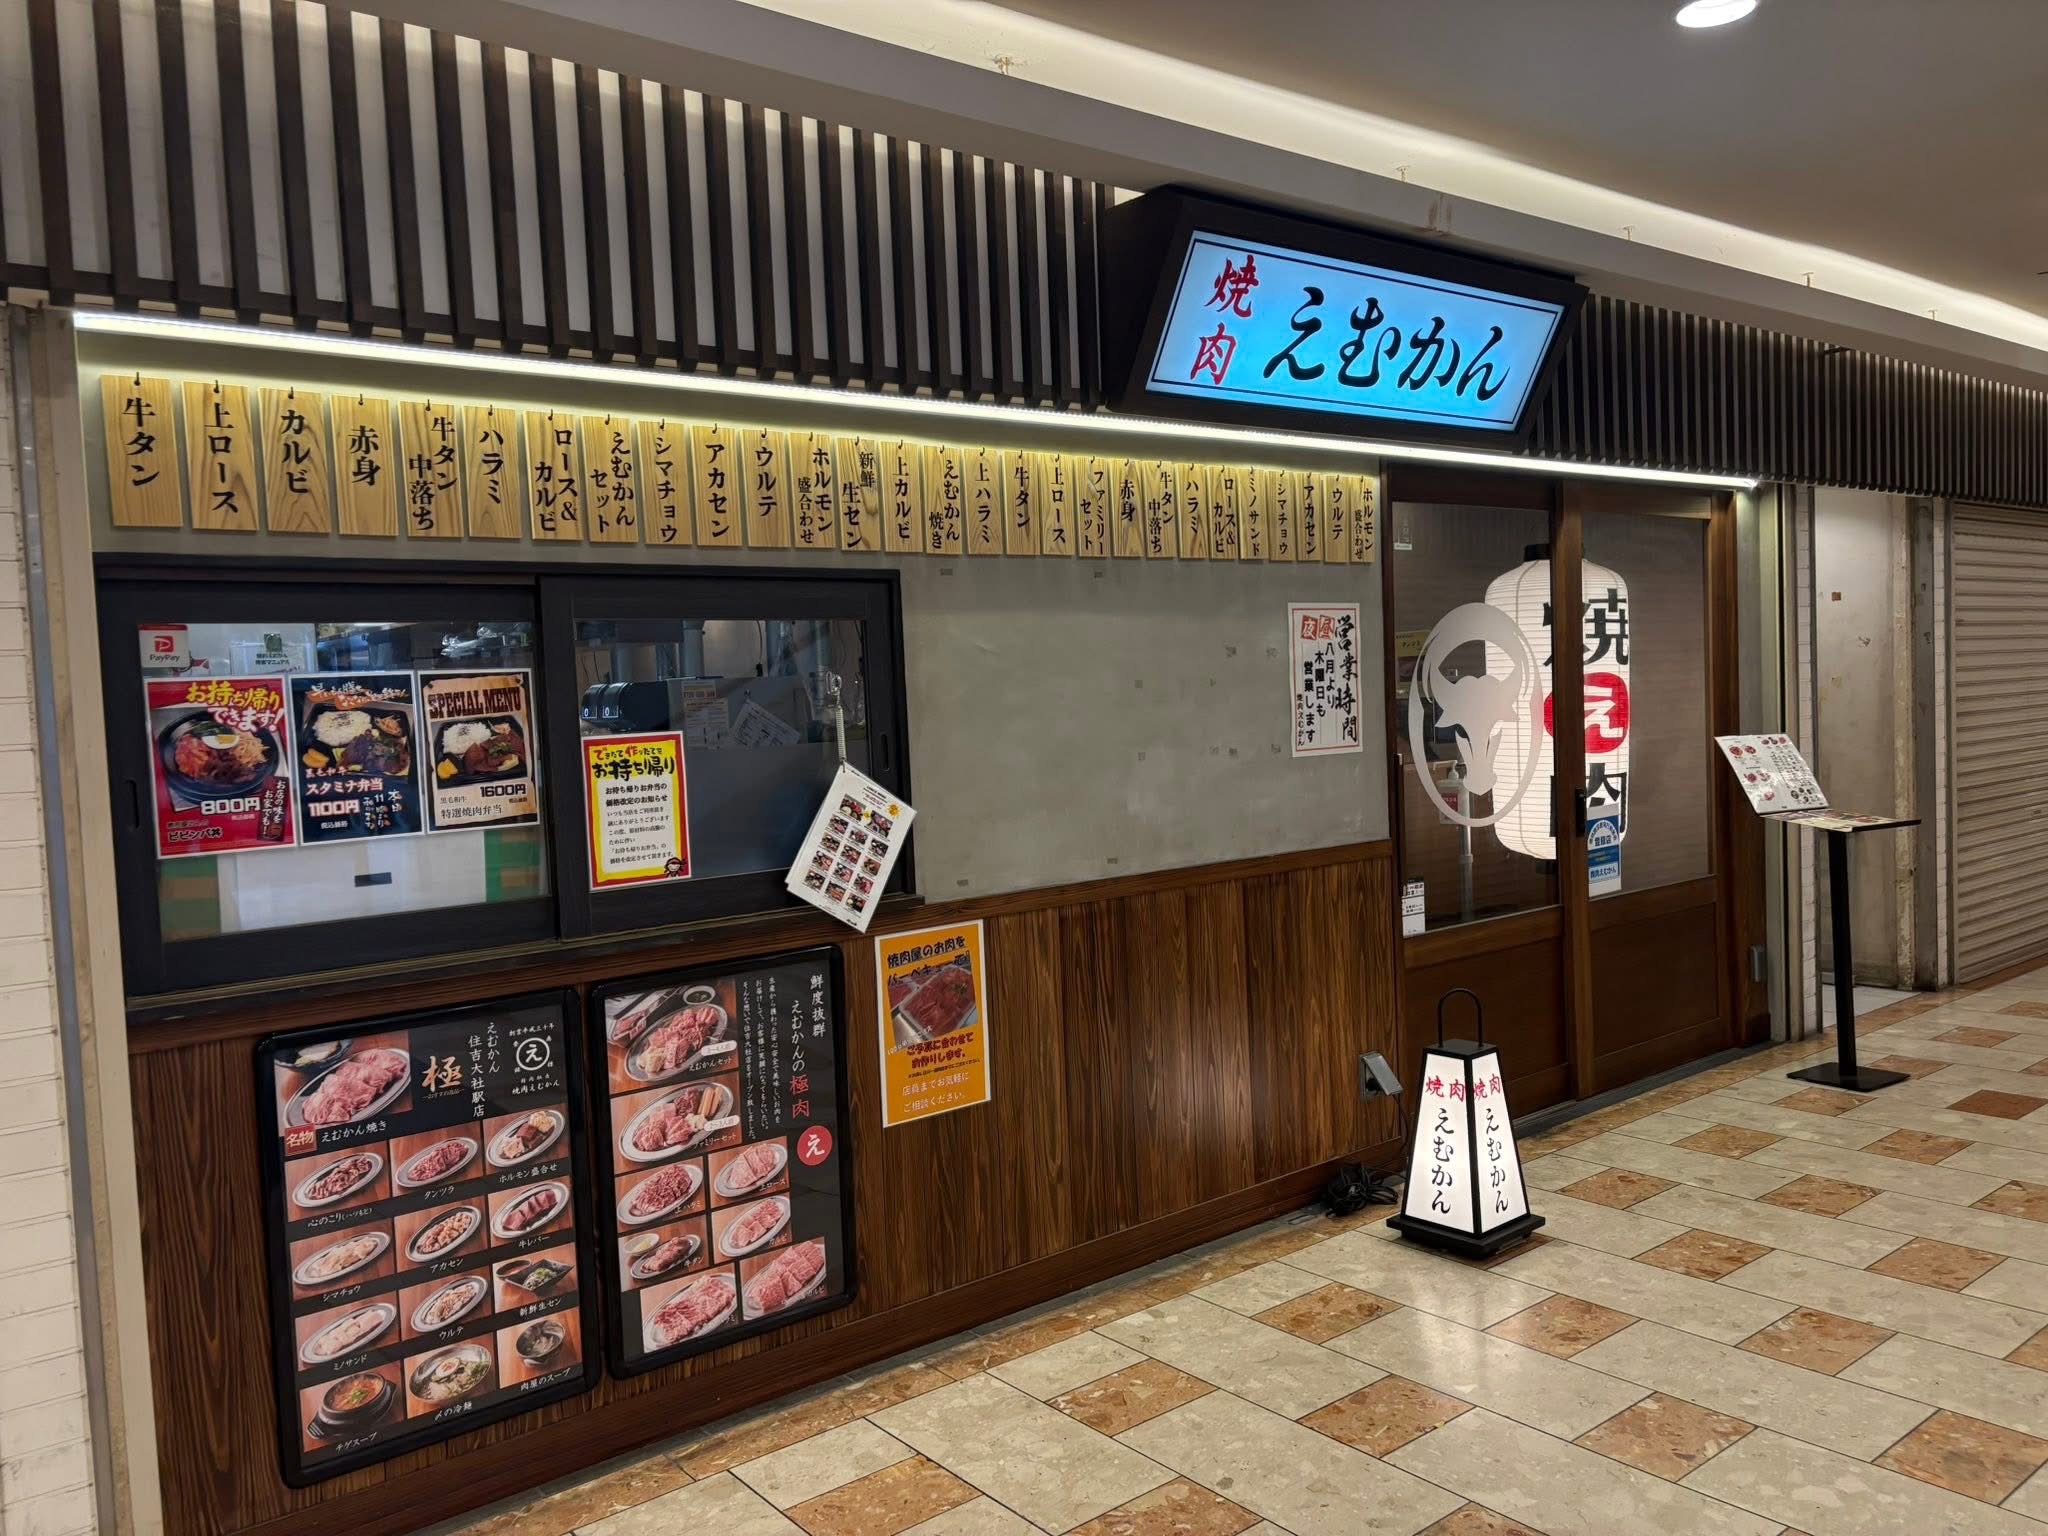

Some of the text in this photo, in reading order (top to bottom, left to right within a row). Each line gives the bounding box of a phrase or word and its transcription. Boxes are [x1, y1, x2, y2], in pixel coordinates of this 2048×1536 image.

[1190, 254, 1260, 386] 焼肉
[1263, 286, 1511, 402] えむかん
[122, 396, 160, 487] 牛タン
[204, 402, 239, 513] 上ロース
[281, 409, 311, 494] カルビ
[348, 425, 381, 486] 赤身
[430, 416, 458, 491] 牛タン
[479, 429, 504, 504] ハラミ
[409, 453, 435, 531] 中落ち
[535, 462, 557, 532] カルビ
[554, 429, 578, 521] ロース&
[610, 431, 635, 527] えむかん
[654, 437, 678, 542] シマチョウ
[705, 444, 729, 538] アカセン
[755, 445, 777, 517] ウルテ
[812, 448, 833, 533] ホルモン
[859, 452, 875, 488] 新鮮
[1014, 466, 1030, 528] 牛タン
[589, 469, 610, 534] セット
[797, 477, 814, 543] 盛合わせ
[842, 482, 862, 548] 生セン
[892, 456, 911, 539] 上カルビ
[943, 459, 960, 541] えむかん
[975, 463, 991, 543] 上ハラミ
[1050, 467, 1066, 543] 上ロース
[1080, 499, 1093, 550] セット
[1093, 471, 1106, 555] ファミリー
[1120, 479, 1135, 522] 赤身
[1160, 471, 1173, 524] 牛タン
[1186, 480, 1200, 534] ハラミ
[1224, 478, 1237, 545] ロース&
[1249, 477, 1260, 556] ミノサンド
[1277, 483, 1289, 554] シマチョウ
[1303, 484, 1317, 555] アカセン
[1332, 488, 1344, 540] ウルテ
[1363, 488, 1374, 550] ホルモン
[929, 511, 943, 549] 焼き
[1148, 498, 1162, 553] 中落ち
[1214, 502, 1225, 553] カルビ
[1303, 616, 1317, 639] 夜
[150, 654, 180, 663] PayPay
[1314, 651, 1326, 718] 木曜日も
[1325, 642, 1336, 709] 八月より
[1335, 614, 1359, 743] 営業時間
[186, 680, 281, 711] お持ち帰り
[208, 707, 284, 732] できます!
[428, 690, 484, 720] SPECIAL
[482, 686, 522, 714] MENU
[1304, 661, 1316, 743] 営業します
[306, 777, 384, 796] スタミナ弁当
[480, 783, 527, 798] 1600円
[592, 756, 676, 782] お持ち帰り
[605, 782, 668, 795] お持ち帰りお弁当の
[201, 797, 261, 816] 800円
[308, 799, 360, 818] 1100円
[441, 804, 503, 820] 特選焼肉弁当
[887, 935, 966, 969] 焼肉屋のお肉を
[810, 973, 826, 1038] 鮮度抜群
[421, 1055, 464, 1092] 極
[487, 1022, 500, 1073] えむかん
[525, 1043, 543, 1063] え
[688, 1057, 733, 1072] えむかんセット
[789, 1000, 810, 1119] えむかんの極肉
[468, 1035, 486, 1118] 住吉大社駅店
[511, 1079, 560, 1095] 焼肉えむかん
[902, 1071, 969, 1097] 店員までお気軽に
[1425, 1075, 1466, 1102] 焼肉
[1473, 1073, 1504, 1101] 焼肉
[286, 1131, 315, 1147] 名物
[320, 1120, 388, 1143] えむかん焼き
[806, 1134, 825, 1158] え
[499, 1163, 558, 1184] ホルモン盛合せ
[1431, 1107, 1455, 1215] えむかん
[1486, 1108, 1509, 1214] えむかん
[423, 1186, 456, 1200] タンツラ
[430, 1258, 464, 1273] アカセン
[518, 1236, 551, 1249] 牛レバー
[322, 1284, 361, 1302] シマチョウ
[520, 1298, 562, 1317] 新鮮生セン
[438, 1326, 465, 1341] ウルテ
[333, 1354, 368, 1371] ミノサンド
